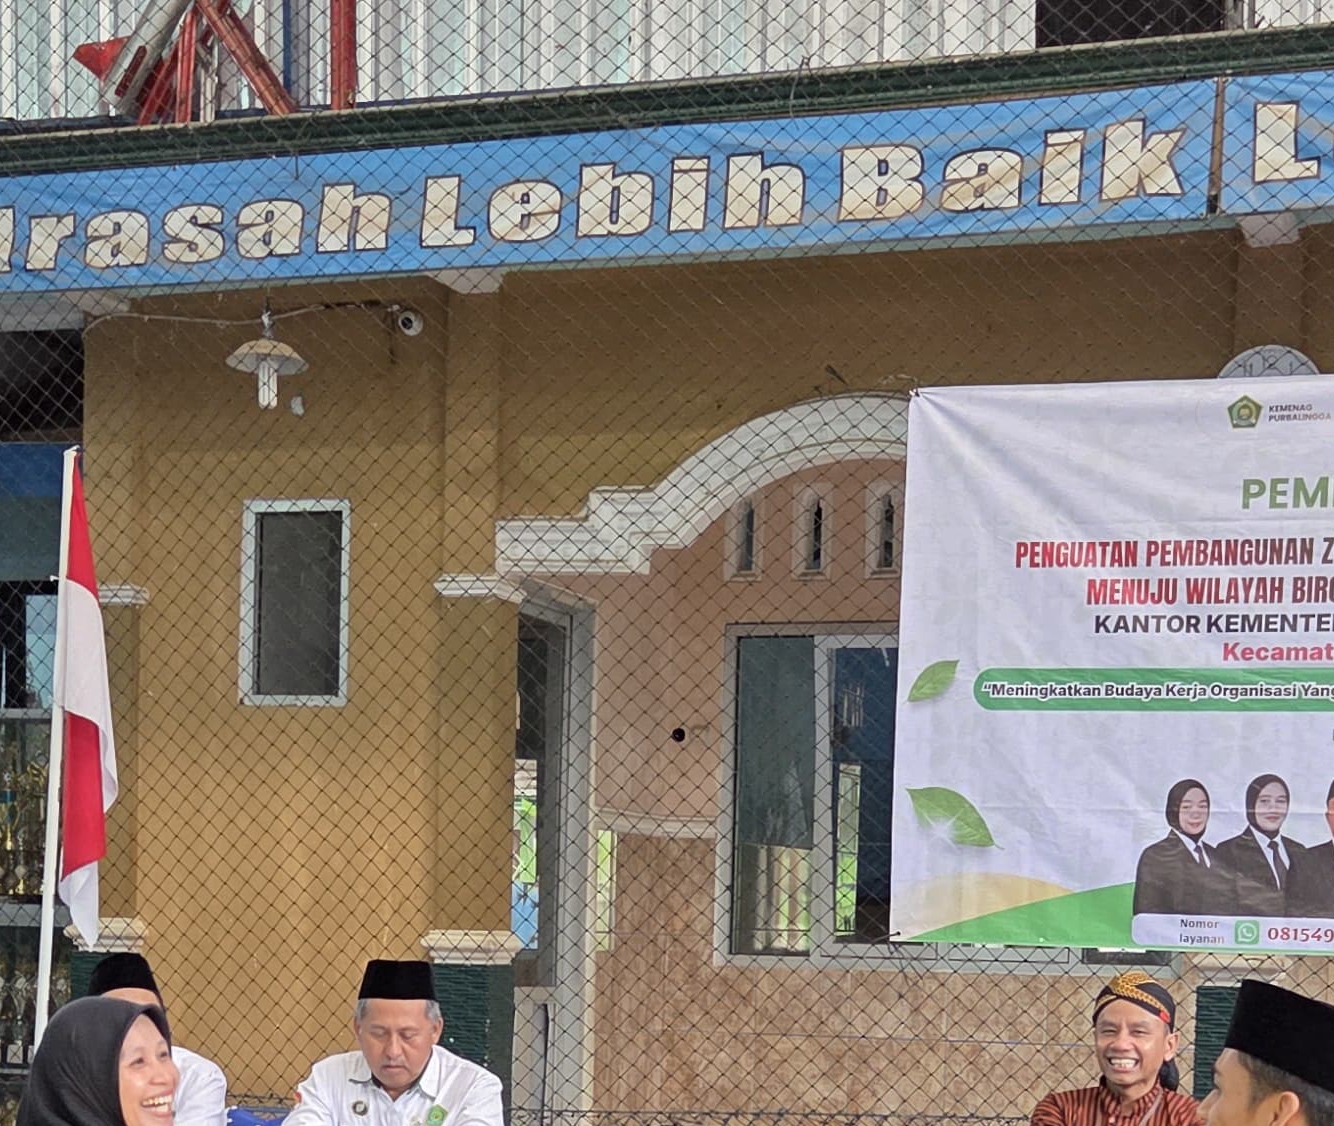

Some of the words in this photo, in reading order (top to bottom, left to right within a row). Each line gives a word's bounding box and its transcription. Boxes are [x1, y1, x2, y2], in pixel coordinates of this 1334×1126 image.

[419, 151, 805, 249] Lebih
[837, 118, 1188, 223] Baik
[1268, 404, 1312, 413] KEMENAG
[1268, 412, 1331, 422] PURBALINGGA
[1015, 540, 1138, 568] PENGUATAN
[1145, 537, 1315, 567] PEMBANGUNAN
[1086, 577, 1178, 605] MENUJU
[1185, 576, 1285, 604] WILAYAH
[1094, 614, 1201, 634] KANTOR
[983, 683, 1101, 698] “Meningkatkan
[1104, 683, 1162, 699] Budaya
[1165, 684, 1207, 699] Kerja
[1210, 683, 1297, 699] Organisasi
[1180, 918, 1219, 929] Nomor
[1179, 933, 1224, 944] layanan
